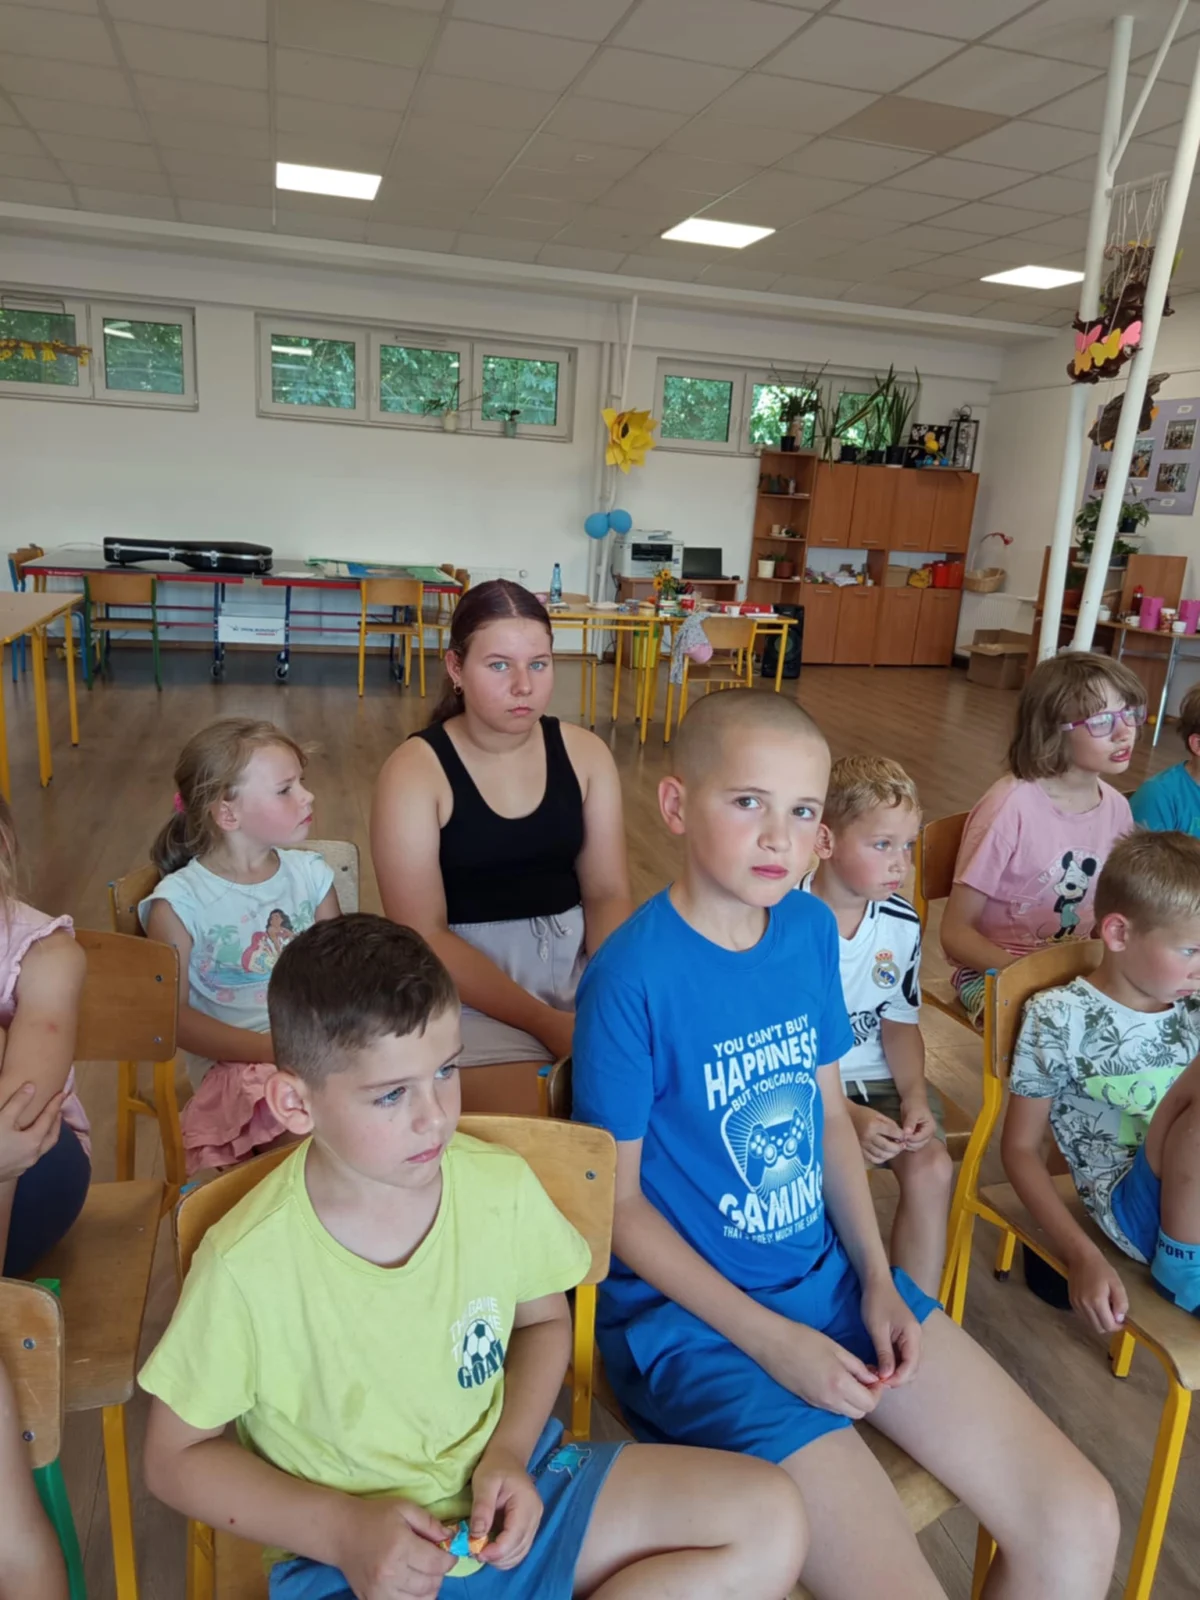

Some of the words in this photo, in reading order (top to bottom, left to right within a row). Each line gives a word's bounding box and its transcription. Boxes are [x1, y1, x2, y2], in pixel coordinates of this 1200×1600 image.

[713, 1037, 744, 1058] YOU
[747, 1024, 782, 1049] CAN'T
[785, 1013, 809, 1035] BUY
[731, 1088, 752, 1112] BUT
[752, 1077, 775, 1097] YOU
[773, 1071, 794, 1088] CAN
[795, 1070, 810, 1085] GO
